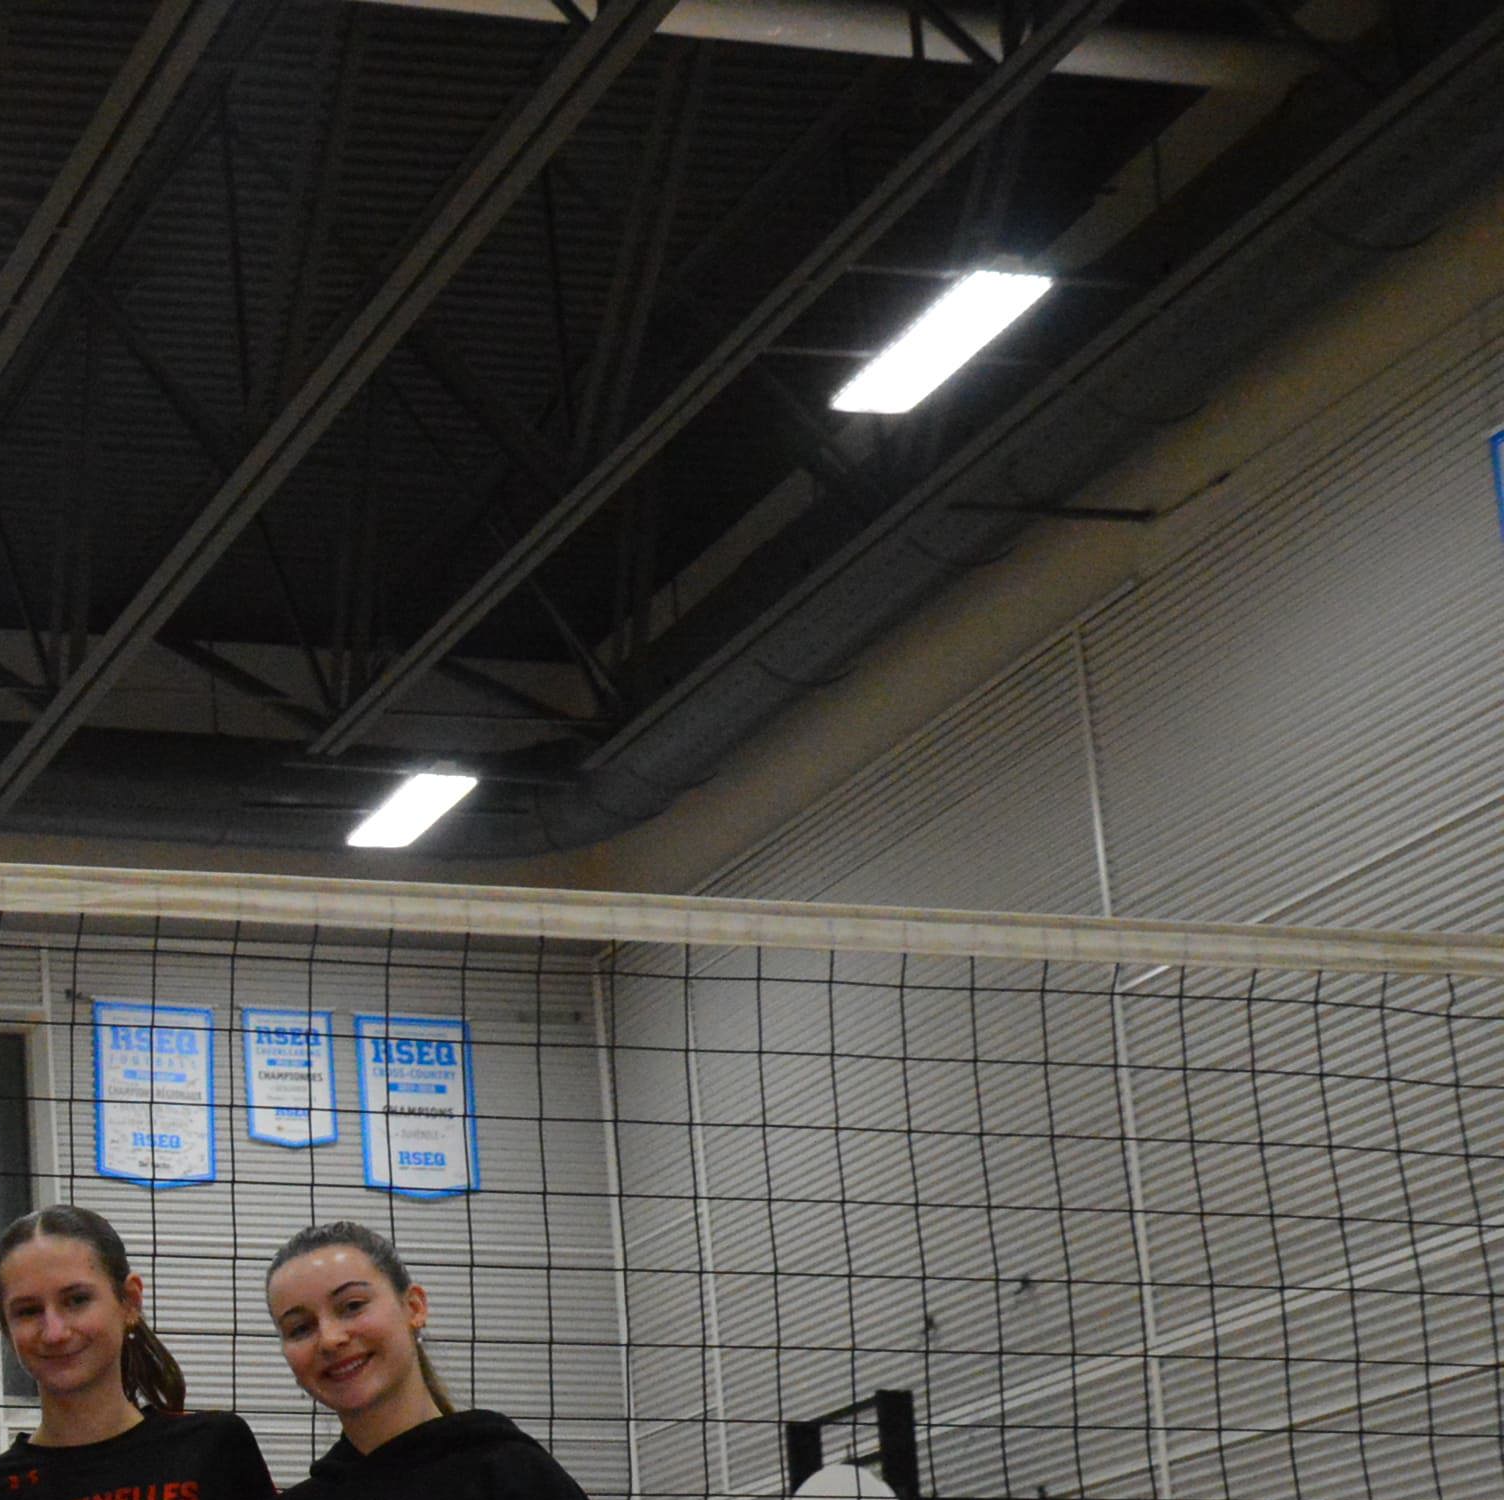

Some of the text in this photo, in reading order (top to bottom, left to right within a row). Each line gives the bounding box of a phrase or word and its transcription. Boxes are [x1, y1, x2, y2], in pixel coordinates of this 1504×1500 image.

[110, 1025, 199, 1055] RSEQ
[255, 1026, 321, 1046] RSEQ
[371, 1038, 458, 1066] RSEQ
[131, 1132, 182, 1148] RSEQ
[398, 1151, 447, 1167] RSEQ
